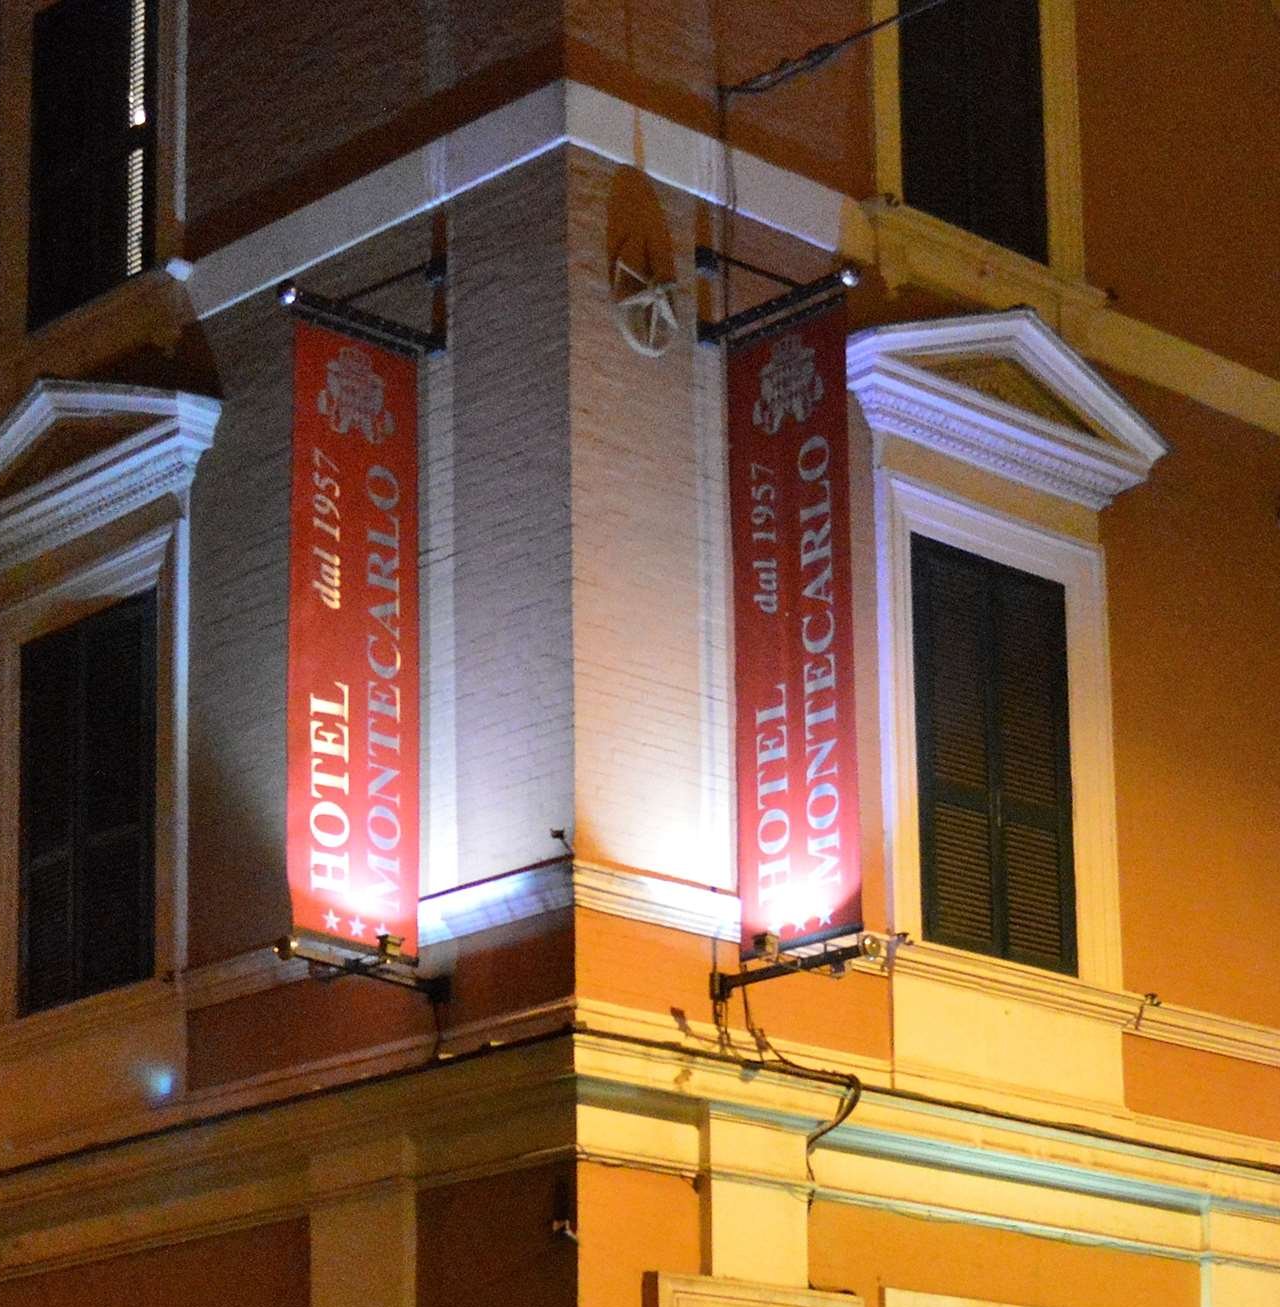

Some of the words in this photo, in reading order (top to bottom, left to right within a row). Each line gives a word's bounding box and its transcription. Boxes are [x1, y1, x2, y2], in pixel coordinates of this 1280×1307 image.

[312, 448, 340, 542] 1957
[751, 463, 777, 543] 1957
[312, 546, 341, 609] dal
[752, 558, 779, 615] dal
[367, 464, 401, 910] MONTECARLO
[799, 435, 842, 888] MONTECARLO
[309, 681, 350, 893] HOTEL
[755, 682, 791, 908] HOTEL
